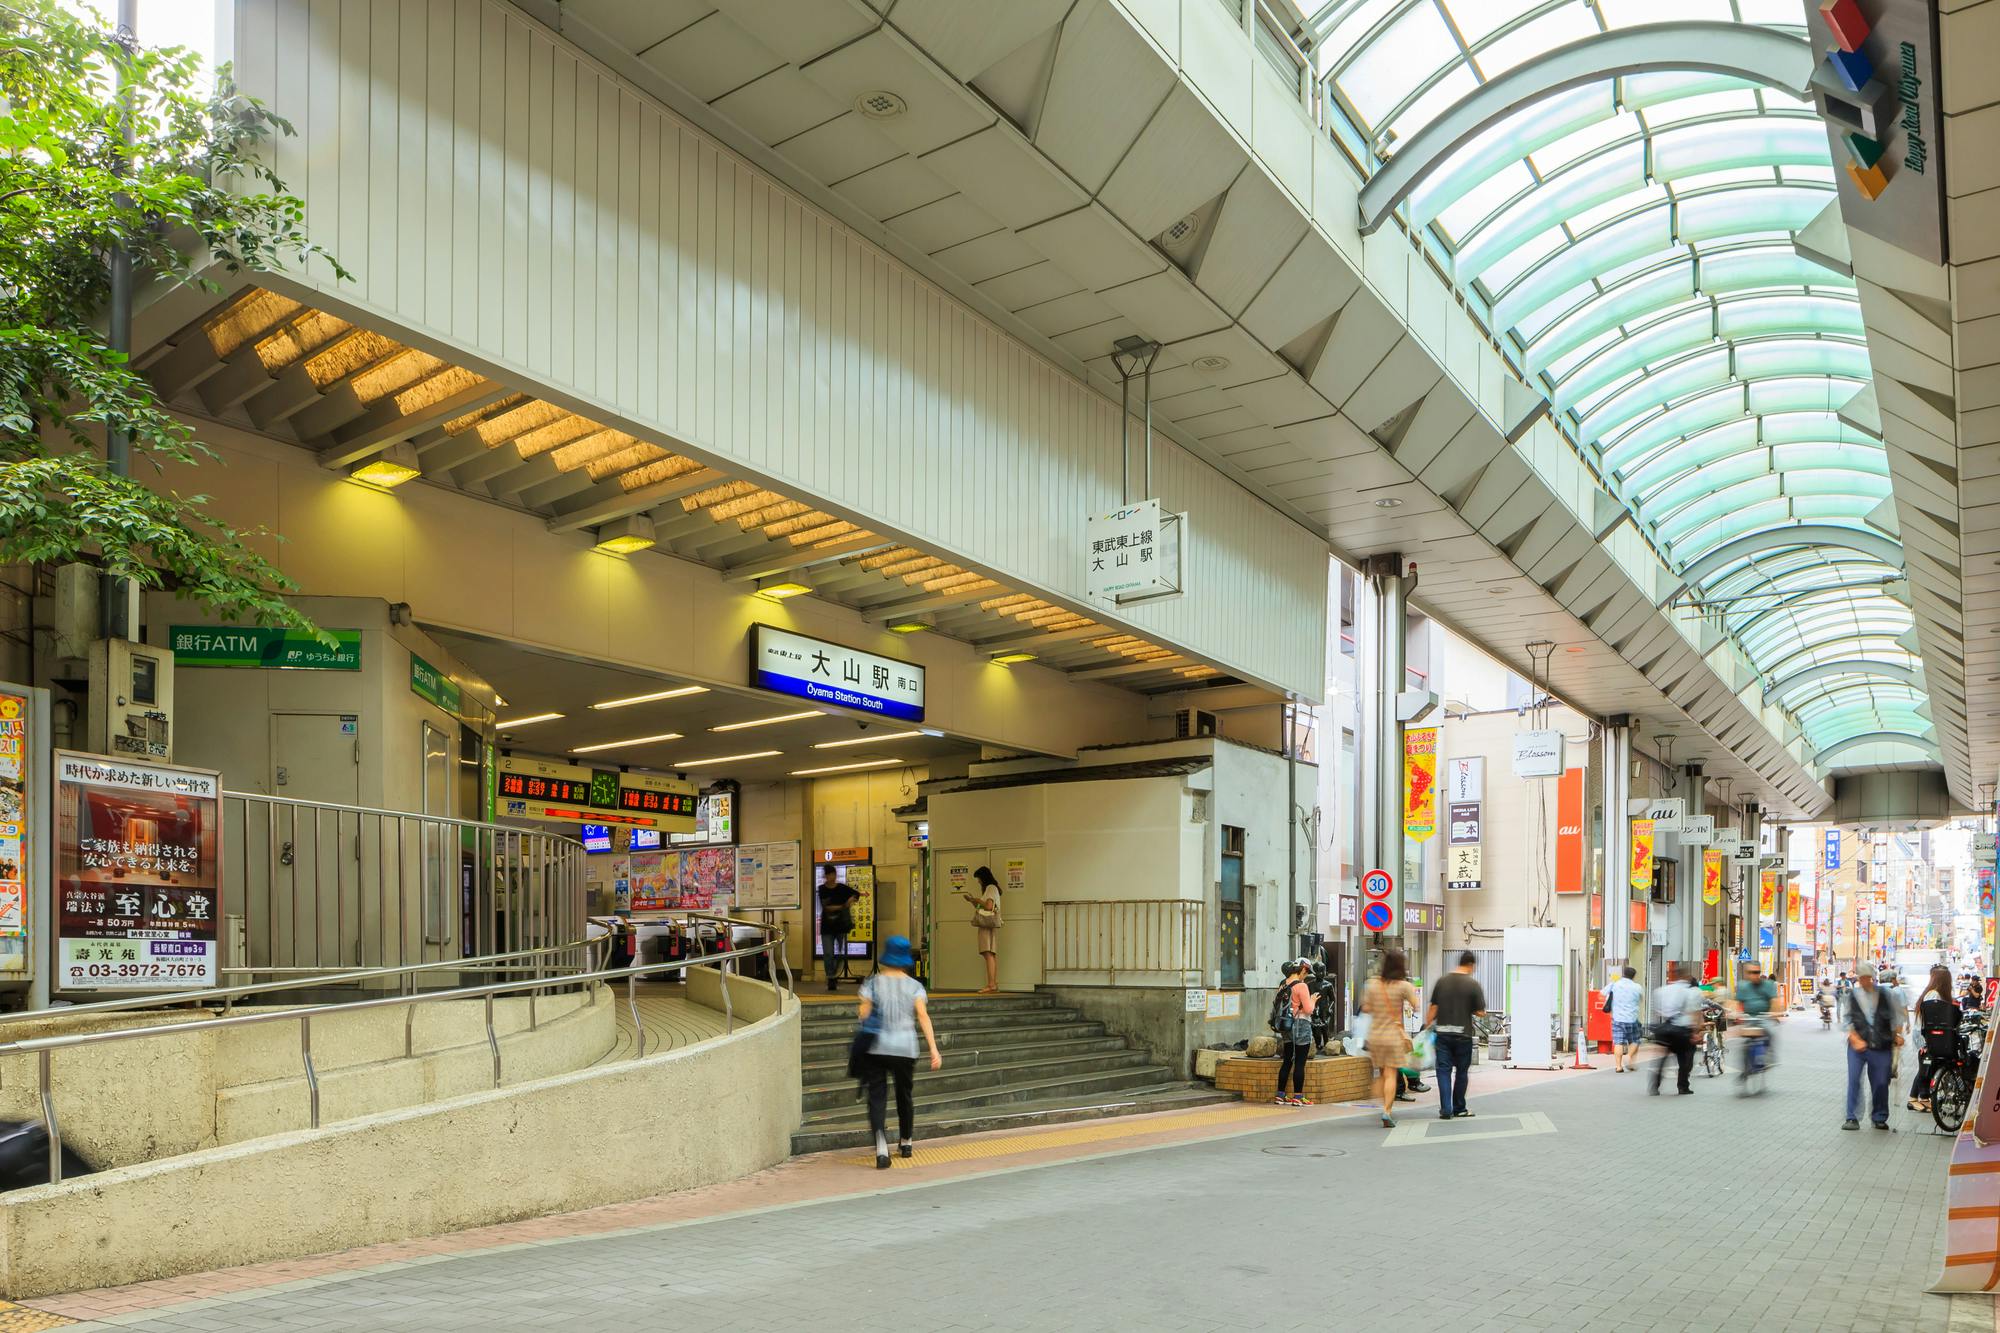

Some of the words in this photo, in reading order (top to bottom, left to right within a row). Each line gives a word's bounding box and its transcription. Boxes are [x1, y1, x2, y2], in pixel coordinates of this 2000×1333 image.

[1092, 530, 1153, 554] 東武東上線
[1092, 547, 1153, 572] 大山駅
[176, 634, 257, 652] 銀行ATM
[306, 652, 354, 663] ゆうちょ銀行
[811, 650, 889, 691] 大山駅
[897, 676, 918, 692] 南口
[835, 692, 861, 706] Station
[862, 697, 884, 710] South
[1516, 748, 1556, 761] Blossom
[505, 759, 512, 769] 2
[65, 763, 210, 794] 時代が求めた新しい納骨堂
[1651, 808, 1677, 820] au
[1466, 824, 1477, 835] 本
[1559, 826, 1581, 835] au
[80, 838, 198, 860] ご家族も納得される
[84, 852, 195, 873] 安心できる未来を。
[1457, 851, 1472, 880] 文蔵
[1368, 878, 1386, 892] 30
[115, 891, 210, 920] 至心堂
[1348, 904, 1355, 920] 本
[107, 918, 135, 927] 50万円
[1405, 908, 1420, 923] ORE
[153, 943, 182, 954] 当駅南口
[88, 964, 206, 977] 03-3972-7676
